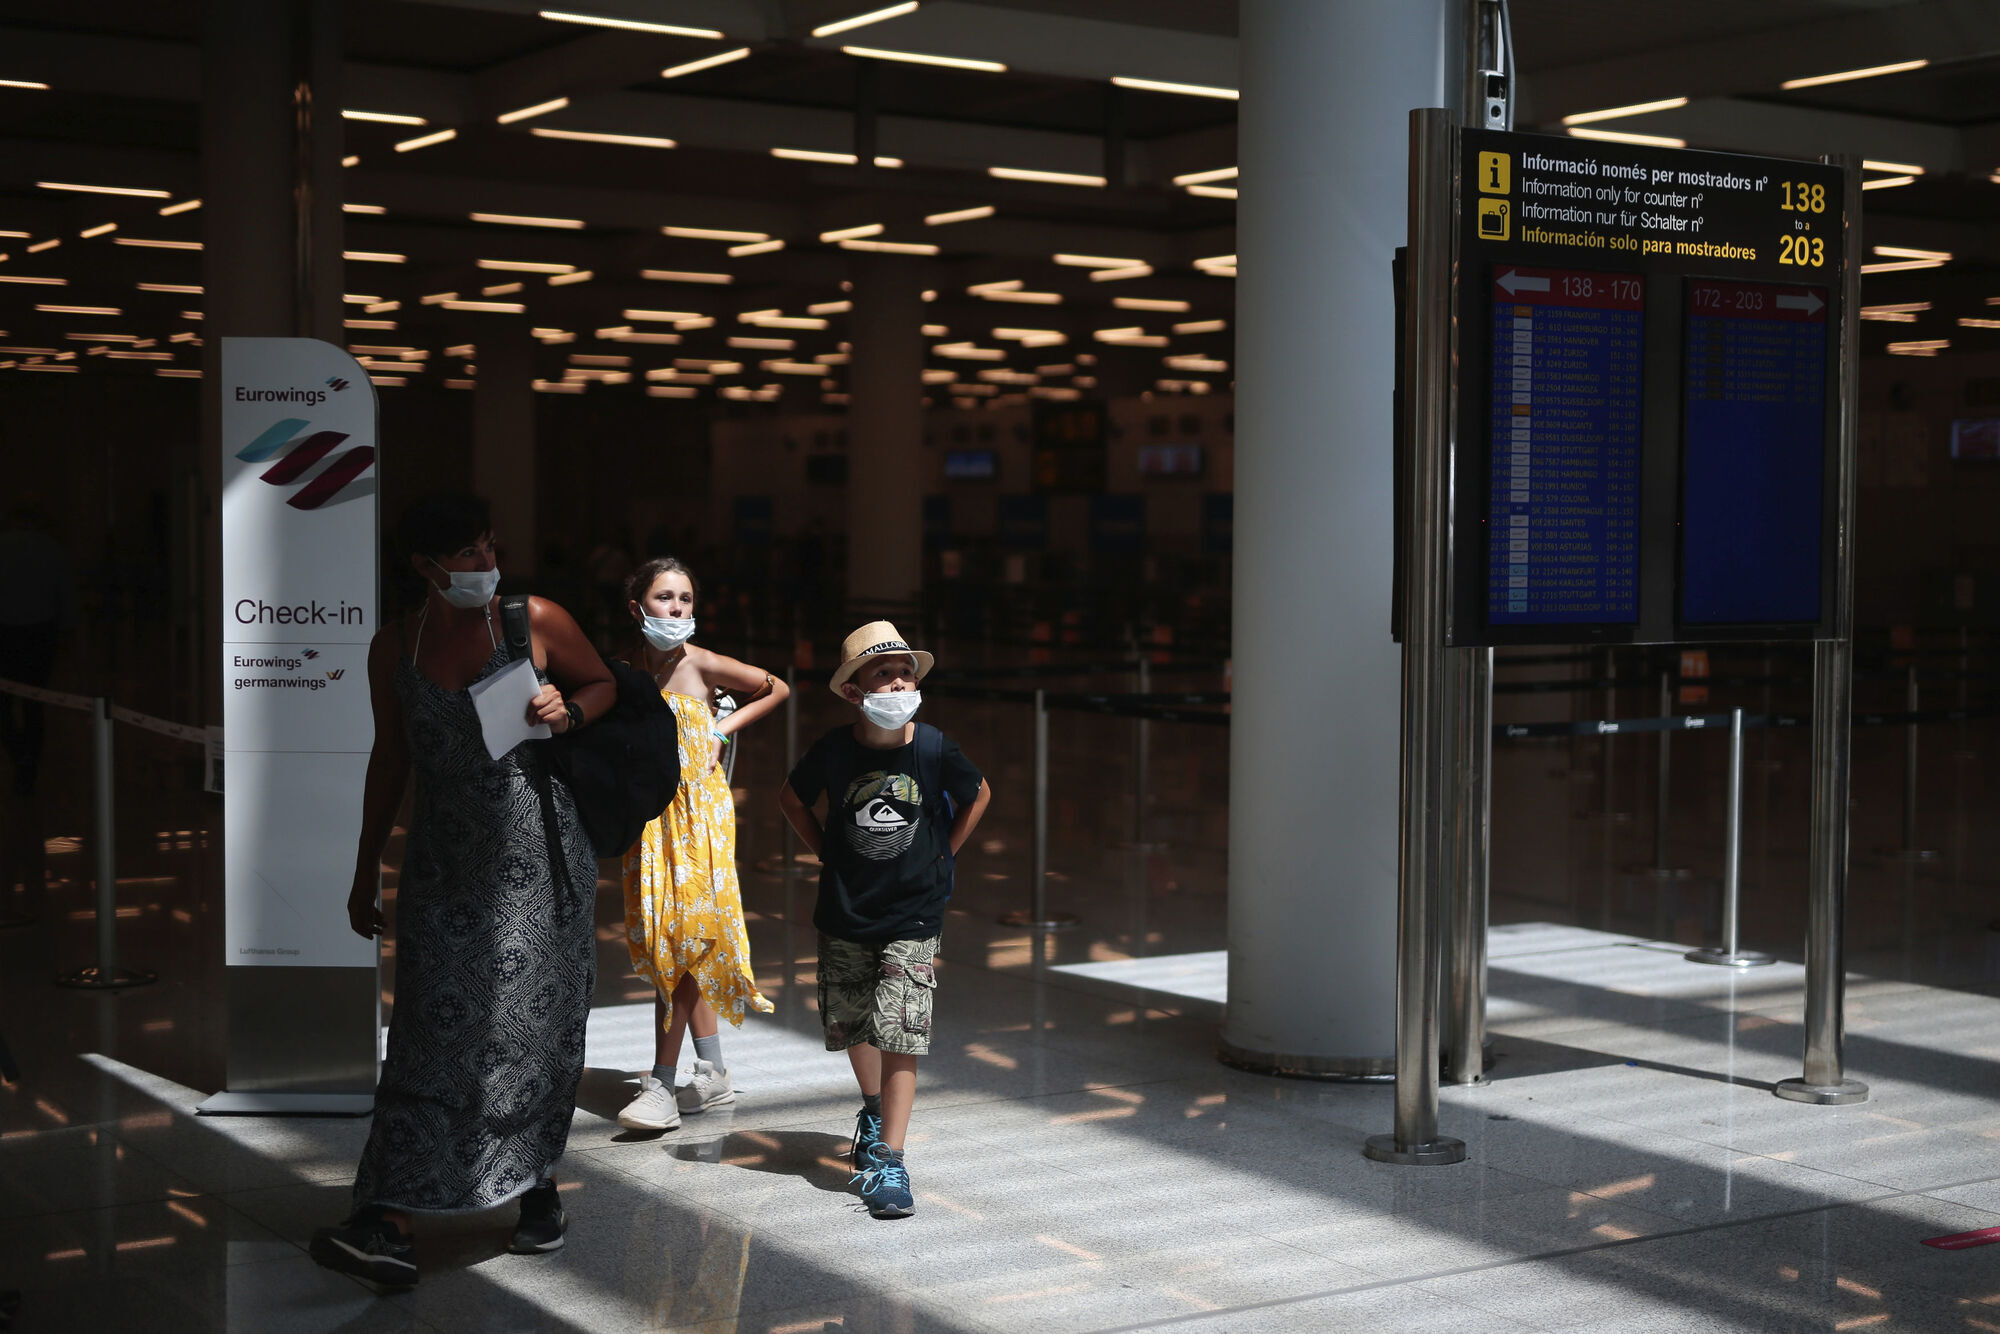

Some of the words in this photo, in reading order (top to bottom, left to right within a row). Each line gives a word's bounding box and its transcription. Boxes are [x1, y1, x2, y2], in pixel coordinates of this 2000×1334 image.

[1523, 152, 1597, 176] Informació
[1603, 161, 1647, 181] només
[1652, 168, 1673, 185] per
[1678, 170, 1751, 191] mostradors
[1522, 177, 1592, 199] Information
[1595, 184, 1621, 205] only
[1624, 187, 1640, 203] for
[1644, 189, 1687, 207] counter
[1781, 182, 1825, 214] 138
[1522, 202, 1592, 224] Information
[1596, 209, 1616, 226] nur
[1620, 210, 1637, 227] für
[1640, 211, 1688, 231] Schalter
[1795, 220, 1803, 230] to
[1805, 222, 1810, 231] a
[1522, 226, 1606, 247] Información
[1610, 232, 1637, 250] solo
[1642, 238, 1672, 256] para
[1676, 241, 1756, 260] mostradores
[1779, 235, 1824, 267] 203
[1563, 277, 1592, 298] 138
[1612, 280, 1641, 302] 170
[1695, 288, 1720, 308] 172
[1736, 290, 1763, 311] 203
[1564, 310, 1600, 320] FRANKFURT
[1626, 313, 1638, 322] 15
[1535, 322, 1544, 330] LG
[1563, 324, 1608, 334] LUXEMBURGO
[1563, 336, 1598, 345] HANNOVER
[1563, 348, 1588, 357] ZURICH
[1563, 373, 1600, 382] HAMBURGO
[1563, 385, 1598, 393] ZARAGOZA
[236, 386, 326, 406] Eurowings
[1562, 397, 1605, 406] DUSSELDORF
[1562, 409, 1588, 418] MUNICH
[1562, 421, 1592, 430] ALICANTE
[1562, 446, 1599, 454] STUTTGART
[1561, 458, 1598, 467] HAMBURGO
[1561, 470, 1598, 479] HAMBURGO
[1561, 482, 1587, 491] MUNICH
[1560, 495, 1590, 503] COLONIA
[1560, 519, 1586, 527] NANTES
[1560, 531, 1589, 539] COLONIA
[1560, 543, 1592, 551] ASTURIAS
[1559, 590, 1596, 599] STUTTGART
[235, 599, 363, 625] Check-in
[233, 655, 302, 670] Eurowings
[234, 676, 326, 691] germanwings
[277, 948, 300, 956] Group
